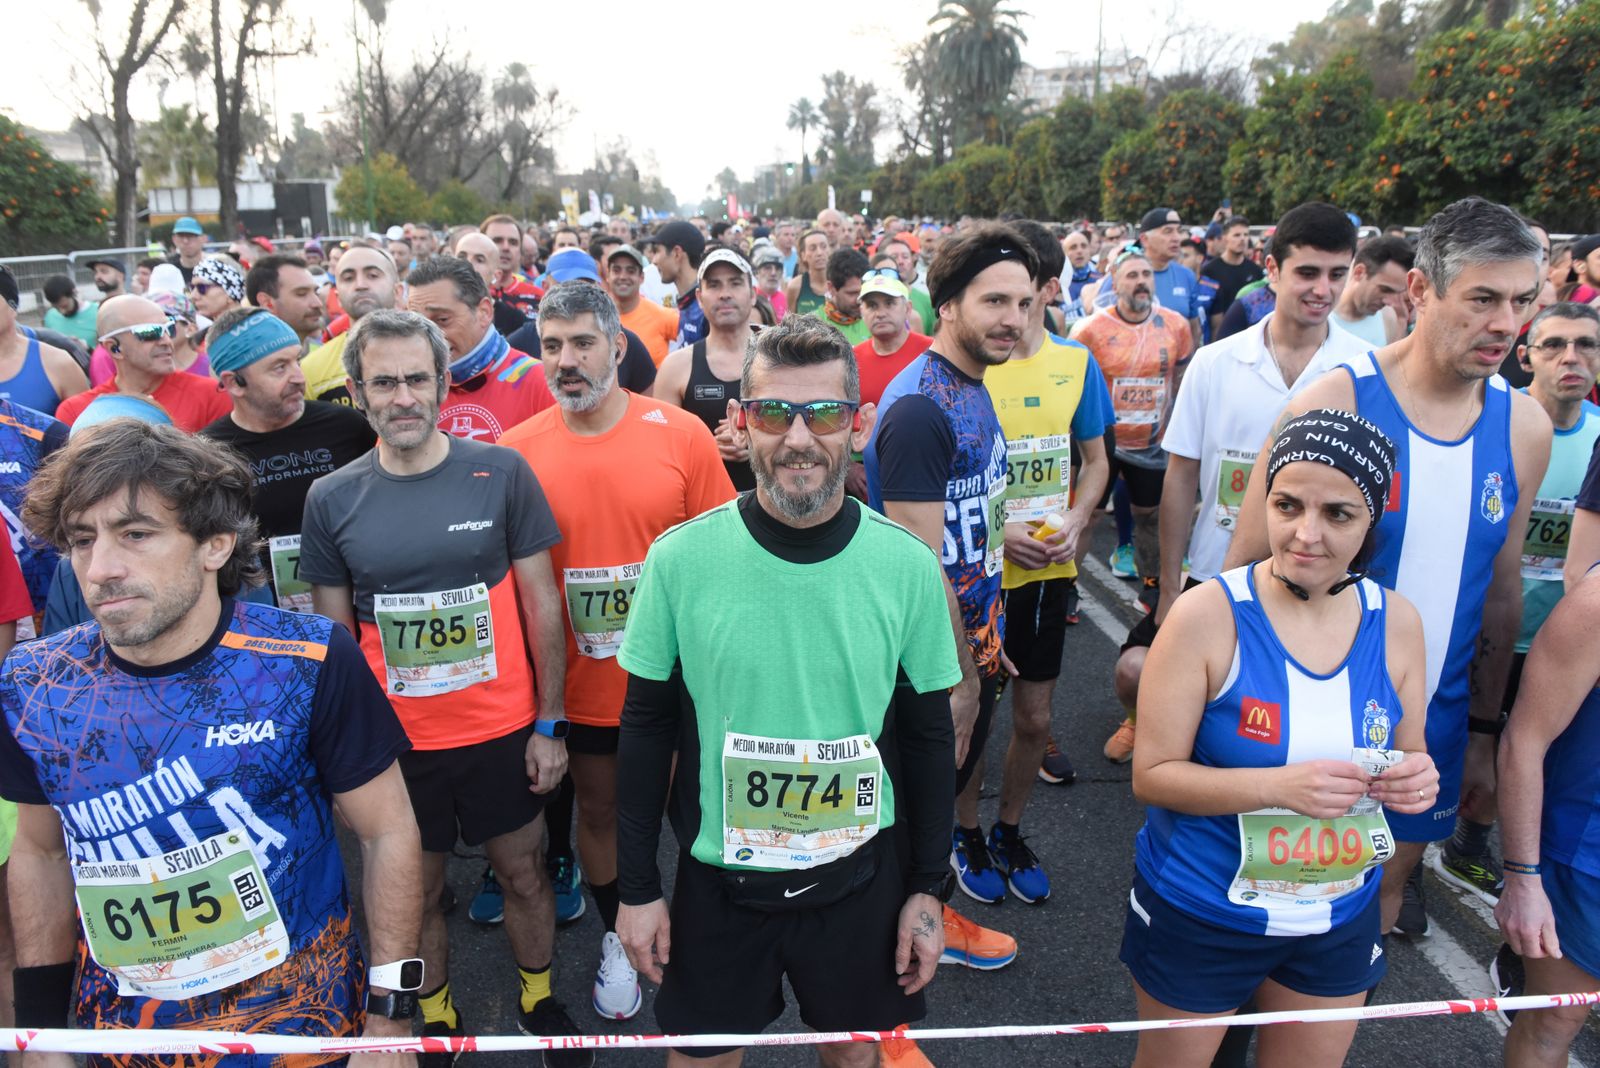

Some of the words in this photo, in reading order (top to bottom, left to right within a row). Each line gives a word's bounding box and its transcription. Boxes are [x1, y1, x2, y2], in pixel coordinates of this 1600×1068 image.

[946, 474, 982, 499] EDIO
[380, 596, 397, 607] MEDIO
[398, 595, 425, 607] MARATÓN
[441, 588, 475, 606] SEVILLA
[392, 615, 467, 649] 7785
[205, 719, 276, 748] HOKA
[733, 738, 755, 752] MEDIO
[758, 741, 795, 756] MARATÓN
[817, 740, 860, 761] SEVILLA
[68, 755, 205, 838] MARATÓN
[746, 770, 843, 812] 8774
[782, 811, 809, 821] Vicente
[163, 838, 223, 874] SEVILLA
[790, 853, 812, 862] HOKA
[1267, 826, 1362, 866] 6409
[100, 862, 141, 879] MARATÓN
[103, 880, 222, 941] 6175
[152, 934, 188, 948] FERMIN
[181, 977, 209, 990] HOKA
